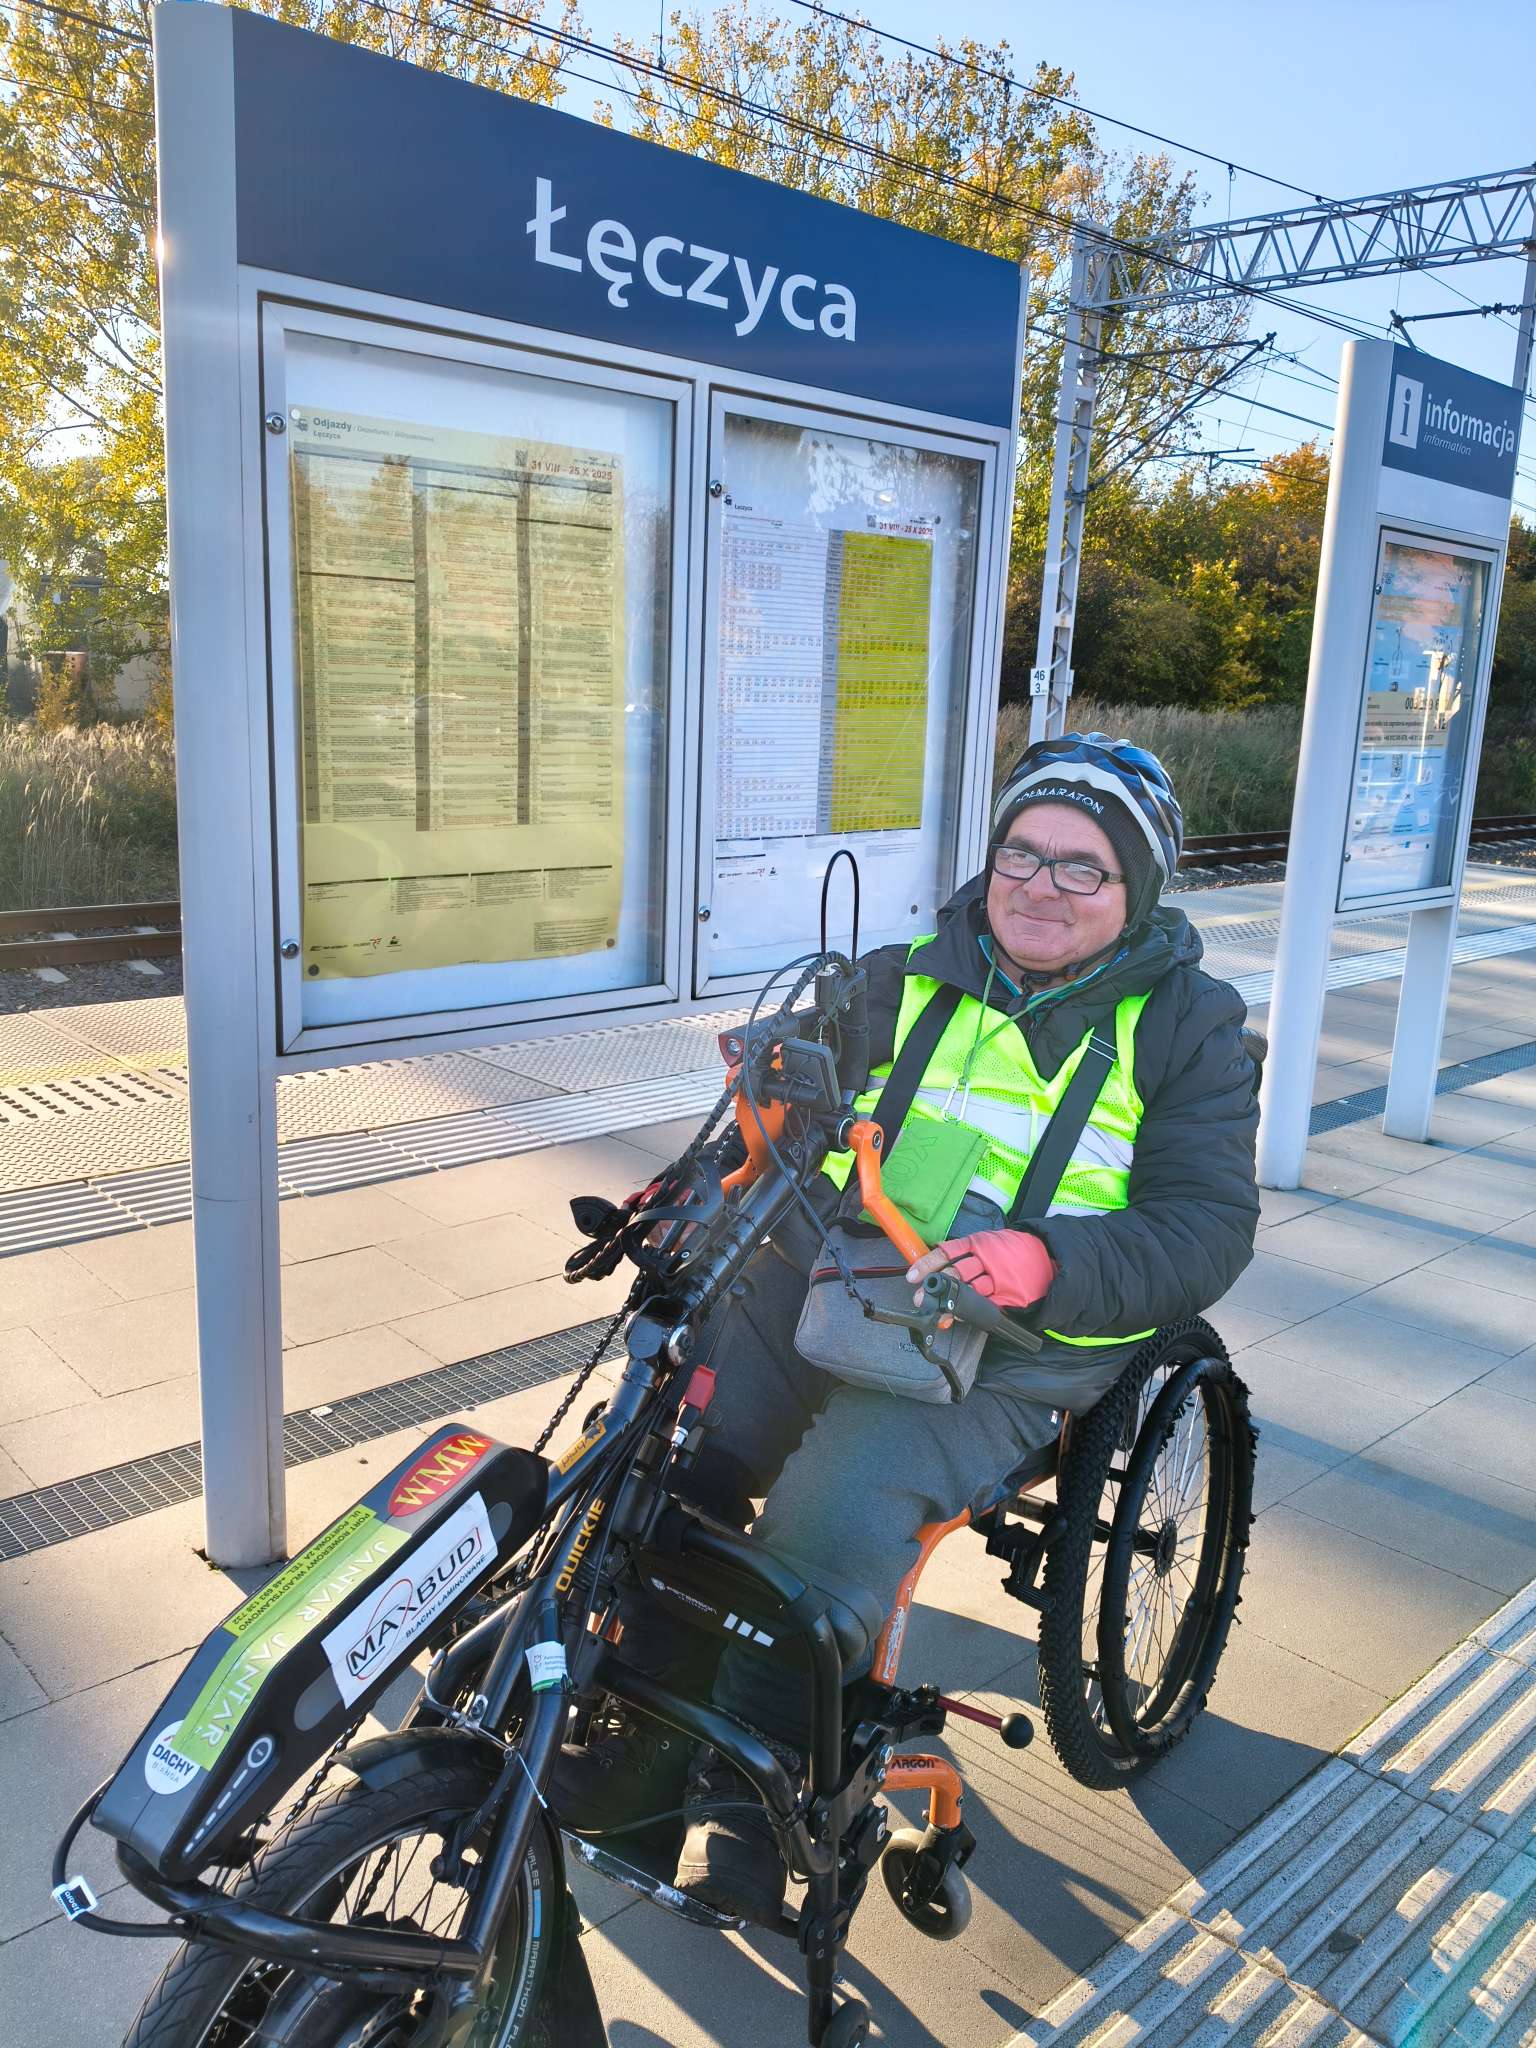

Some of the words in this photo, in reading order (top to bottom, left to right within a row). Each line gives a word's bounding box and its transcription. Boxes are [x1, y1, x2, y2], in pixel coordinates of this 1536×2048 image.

[526, 176, 857, 342] Łęczyca
[313, 417, 352, 432] Odjazdy
[1424, 392, 1516, 458] informacja
[1423, 432, 1472, 456] information
[569, 466, 580, 475] 25
[582, 468, 589, 477] X
[591, 469, 613, 481] 2025
[1033, 670, 1046, 681] 46
[1035, 683, 1041, 693] 3
[395, 1435, 487, 1506] WMW
[313, 1520, 349, 1553] PORTOWA
[349, 1513, 370, 1532] PORT
[304, 1551, 315, 1561] 2A
[306, 1531, 350, 1571] ROWEROWY
[555, 1499, 606, 1592] QUICKIE
[259, 1587, 274, 1601] 693
[272, 1576, 286, 1589] +48
[296, 1540, 390, 1623] JANTAR
[405, 1605, 437, 1638] BLACHY
[439, 1553, 488, 1605] LAMINOWANE
[349, 1536, 476, 1670] MAXBUD
[201, 1631, 288, 1746] JANTAR
[152, 1744, 194, 1777] DACHY
[516, 1941, 541, 2018] MARATHON
